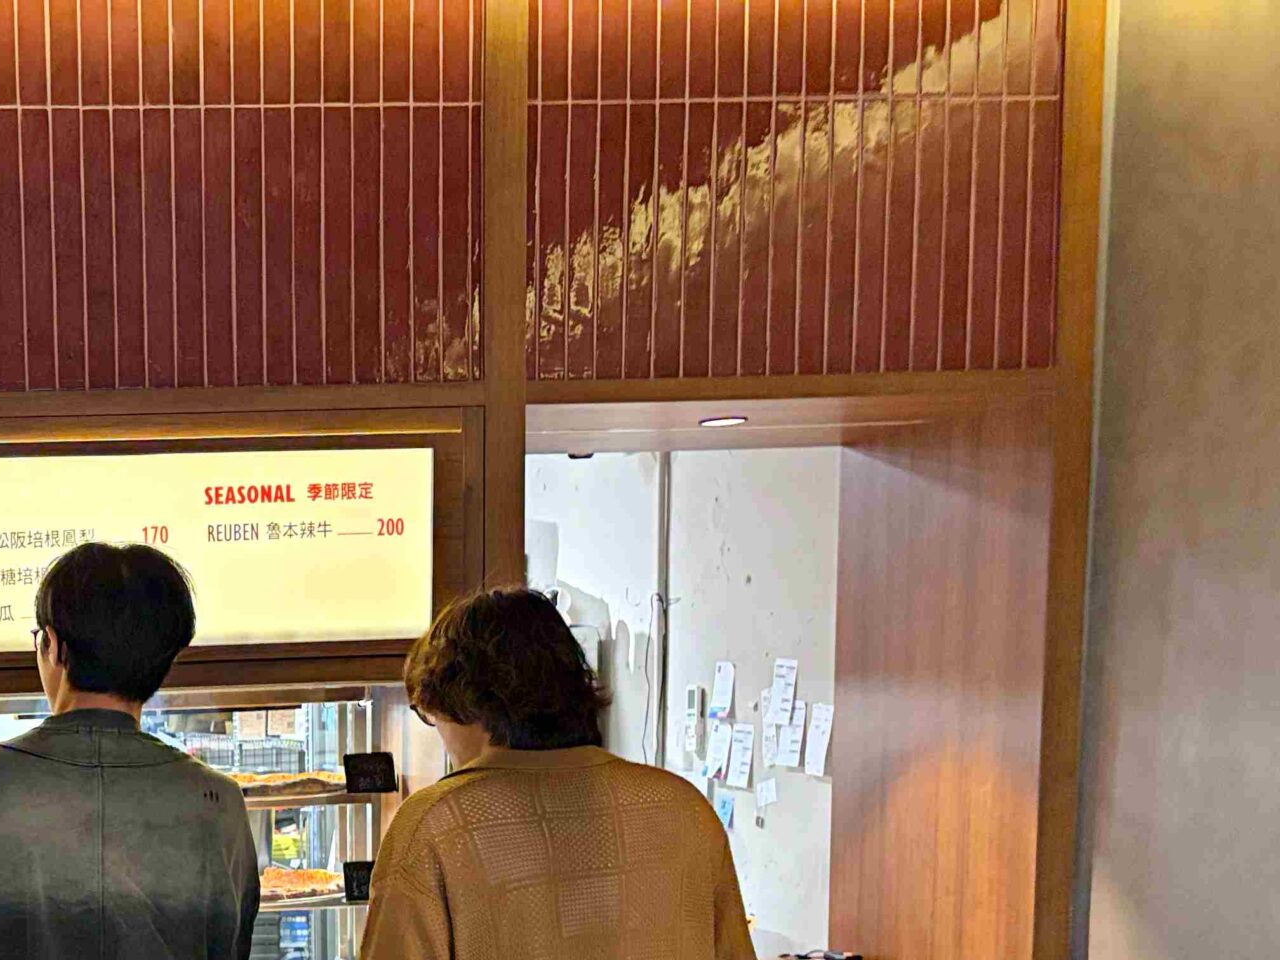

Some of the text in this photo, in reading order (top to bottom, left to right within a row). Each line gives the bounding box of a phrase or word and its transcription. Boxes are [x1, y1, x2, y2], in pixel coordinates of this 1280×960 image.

[204, 481, 374, 505] SEASONAL 季節限定
[142, 525, 170, 545] 170
[207, 518, 405, 543] REUBEN 魯本辣牛 200
